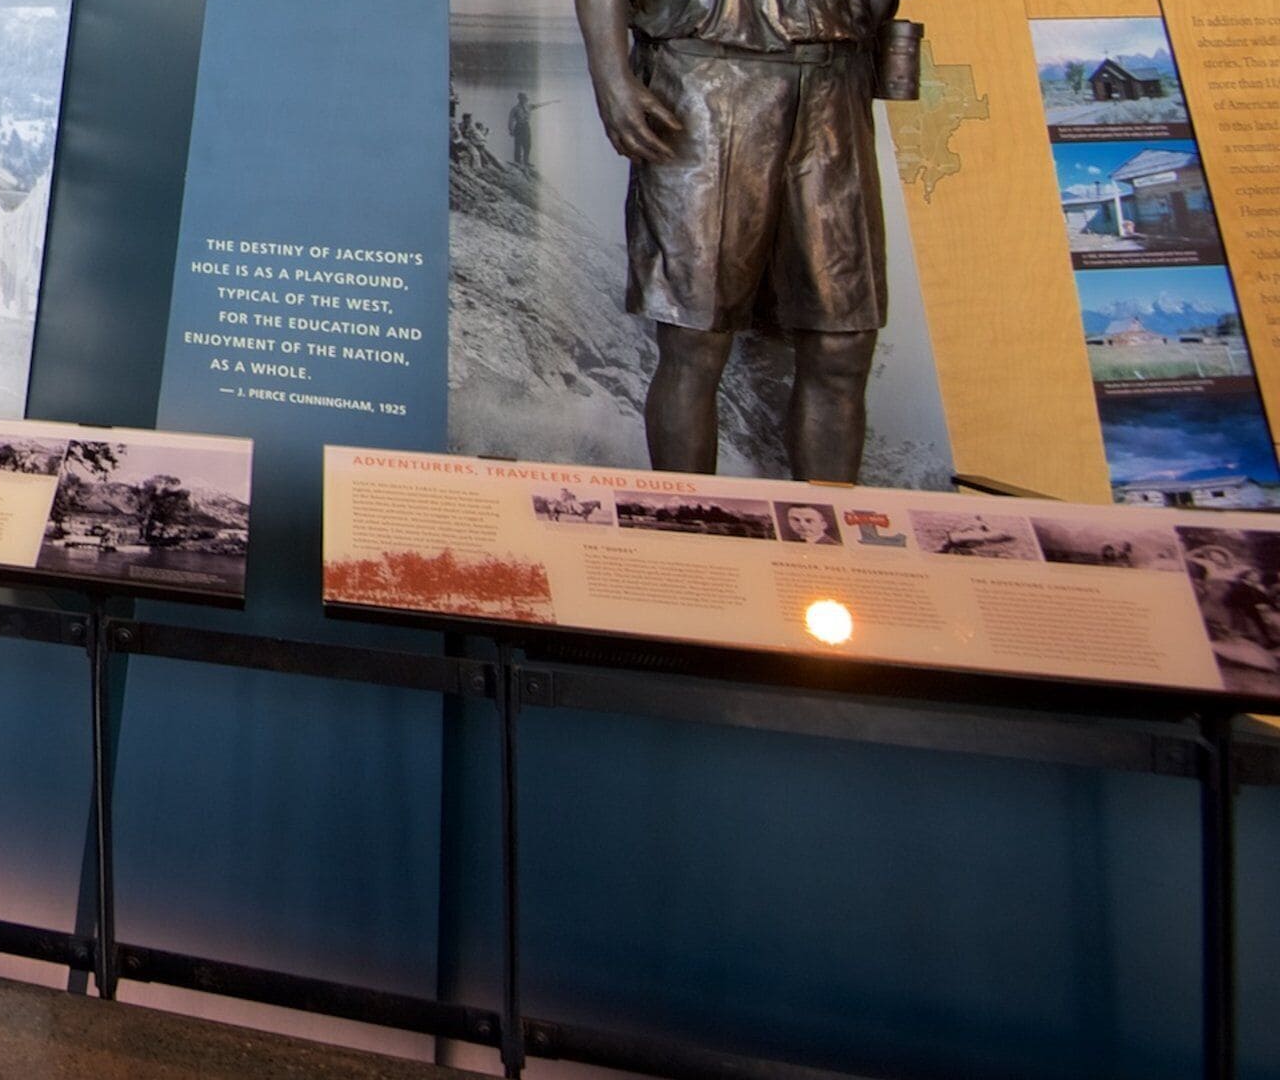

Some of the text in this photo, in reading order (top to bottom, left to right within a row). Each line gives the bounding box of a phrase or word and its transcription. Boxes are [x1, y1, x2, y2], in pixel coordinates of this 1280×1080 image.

[206, 239, 423, 265] THE DESTINY OF JACKSON'S
[191, 262, 408, 289] HOLE IS AS A PLAYGROUND,
[218, 287, 393, 314] TYPICAL OF THE WEST,
[219, 311, 422, 340] FOR THE EDUCATION AND
[184, 332, 409, 365] ENJOYMENT OF THE NATION,
[210, 358, 311, 380] AS A WHOLE.
[237, 387, 246, 397] J.
[249, 388, 286, 402] PIERCE
[289, 393, 374, 412] CUNNINGHAM,
[379, 403, 406, 415] 1925
[353, 457, 698, 494] ADVENTURERS, TRAVELERS AND DUDES
